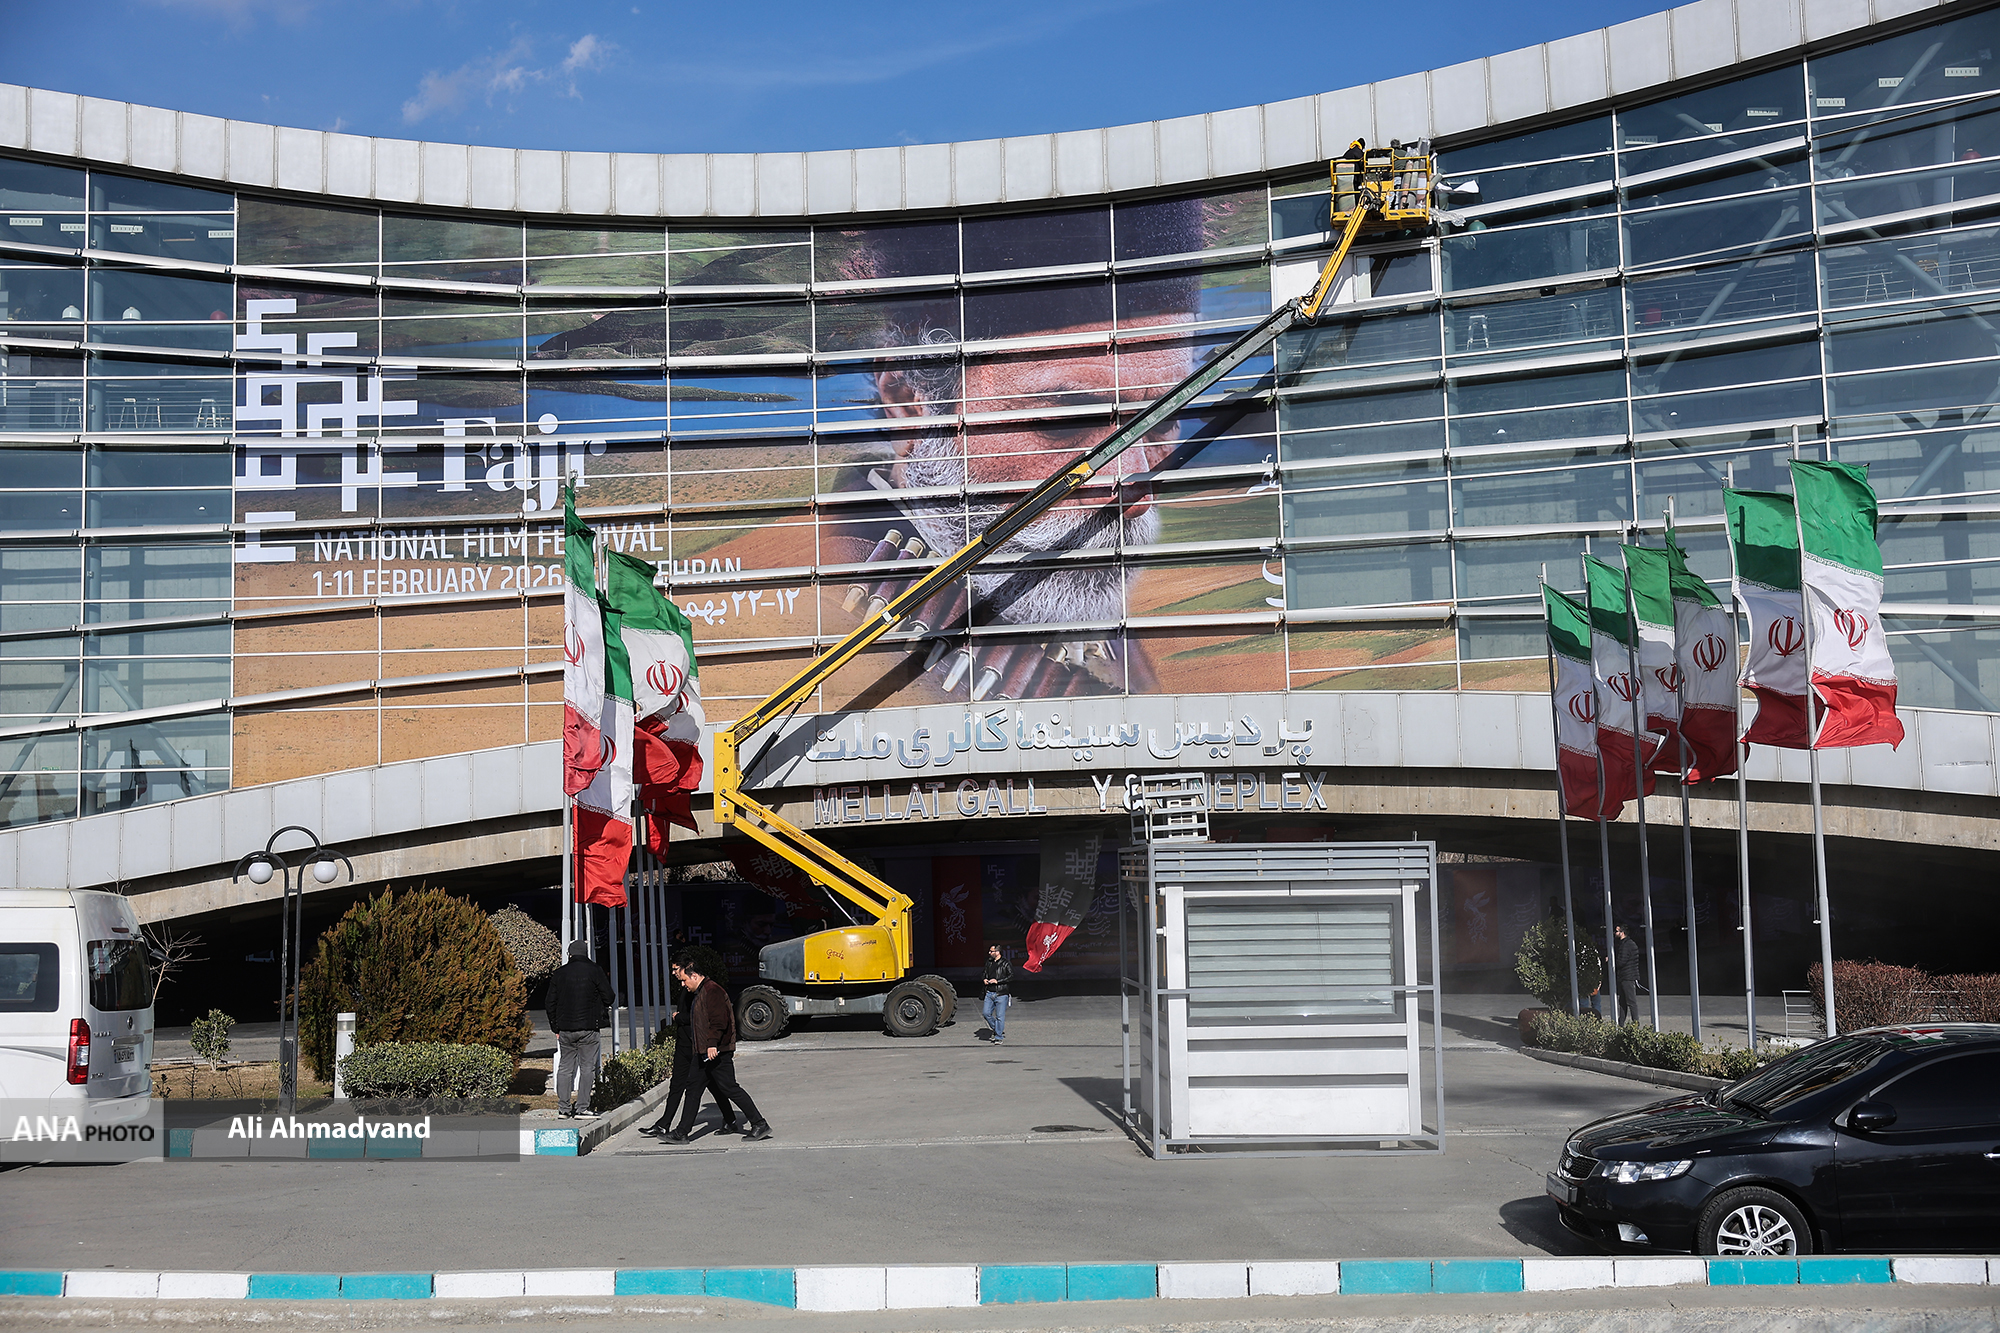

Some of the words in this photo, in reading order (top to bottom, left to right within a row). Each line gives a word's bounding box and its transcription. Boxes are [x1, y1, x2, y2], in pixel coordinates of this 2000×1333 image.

[436, 413, 607, 512] Fajr
[314, 528, 454, 562] NATIONAL
[463, 526, 527, 558] FILM
[538, 522, 664, 556] FETIVAL
[312, 570, 353, 596] 1-11
[363, 566, 493, 596] FEBRUARY
[500, 564, 563, 590] 2026
[644, 557, 742, 585] EHRAN
[804, 718, 892, 762] ملت
[897, 705, 1009, 768] گالری
[1014, 703, 1141, 761] سینما
[1144, 713, 1314, 766] پردیس
[813, 781, 946, 825] MELLAT
